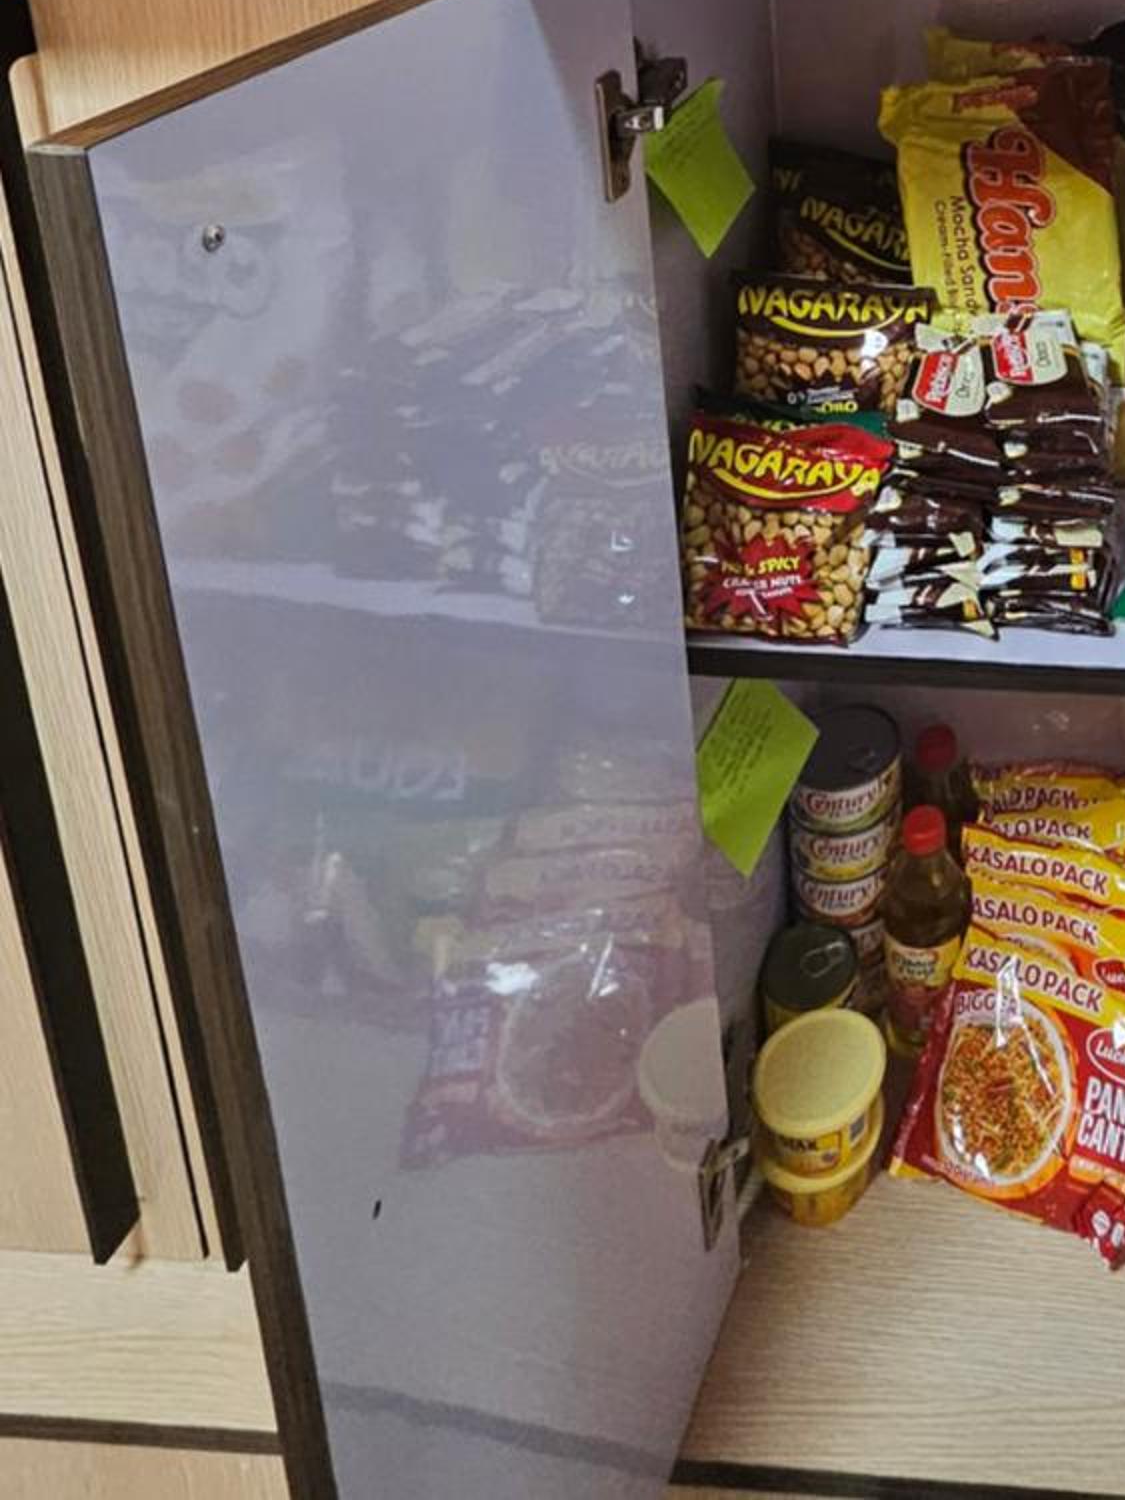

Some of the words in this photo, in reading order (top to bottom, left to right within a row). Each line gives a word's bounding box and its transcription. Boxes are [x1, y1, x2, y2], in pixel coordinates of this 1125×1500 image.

[738, 286, 928, 326] NAGARAYA
[689, 429, 880, 496] NAGARAYA
[757, 556, 801, 575] SPICY
[1033, 818, 1091, 839] PACK
[966, 844, 1049, 877] KASALO
[1050, 859, 1109, 896] PACK
[973, 897, 1039, 926] ASALO
[1041, 906, 1099, 946] PACK
[1043, 976, 1103, 1013] PACK
